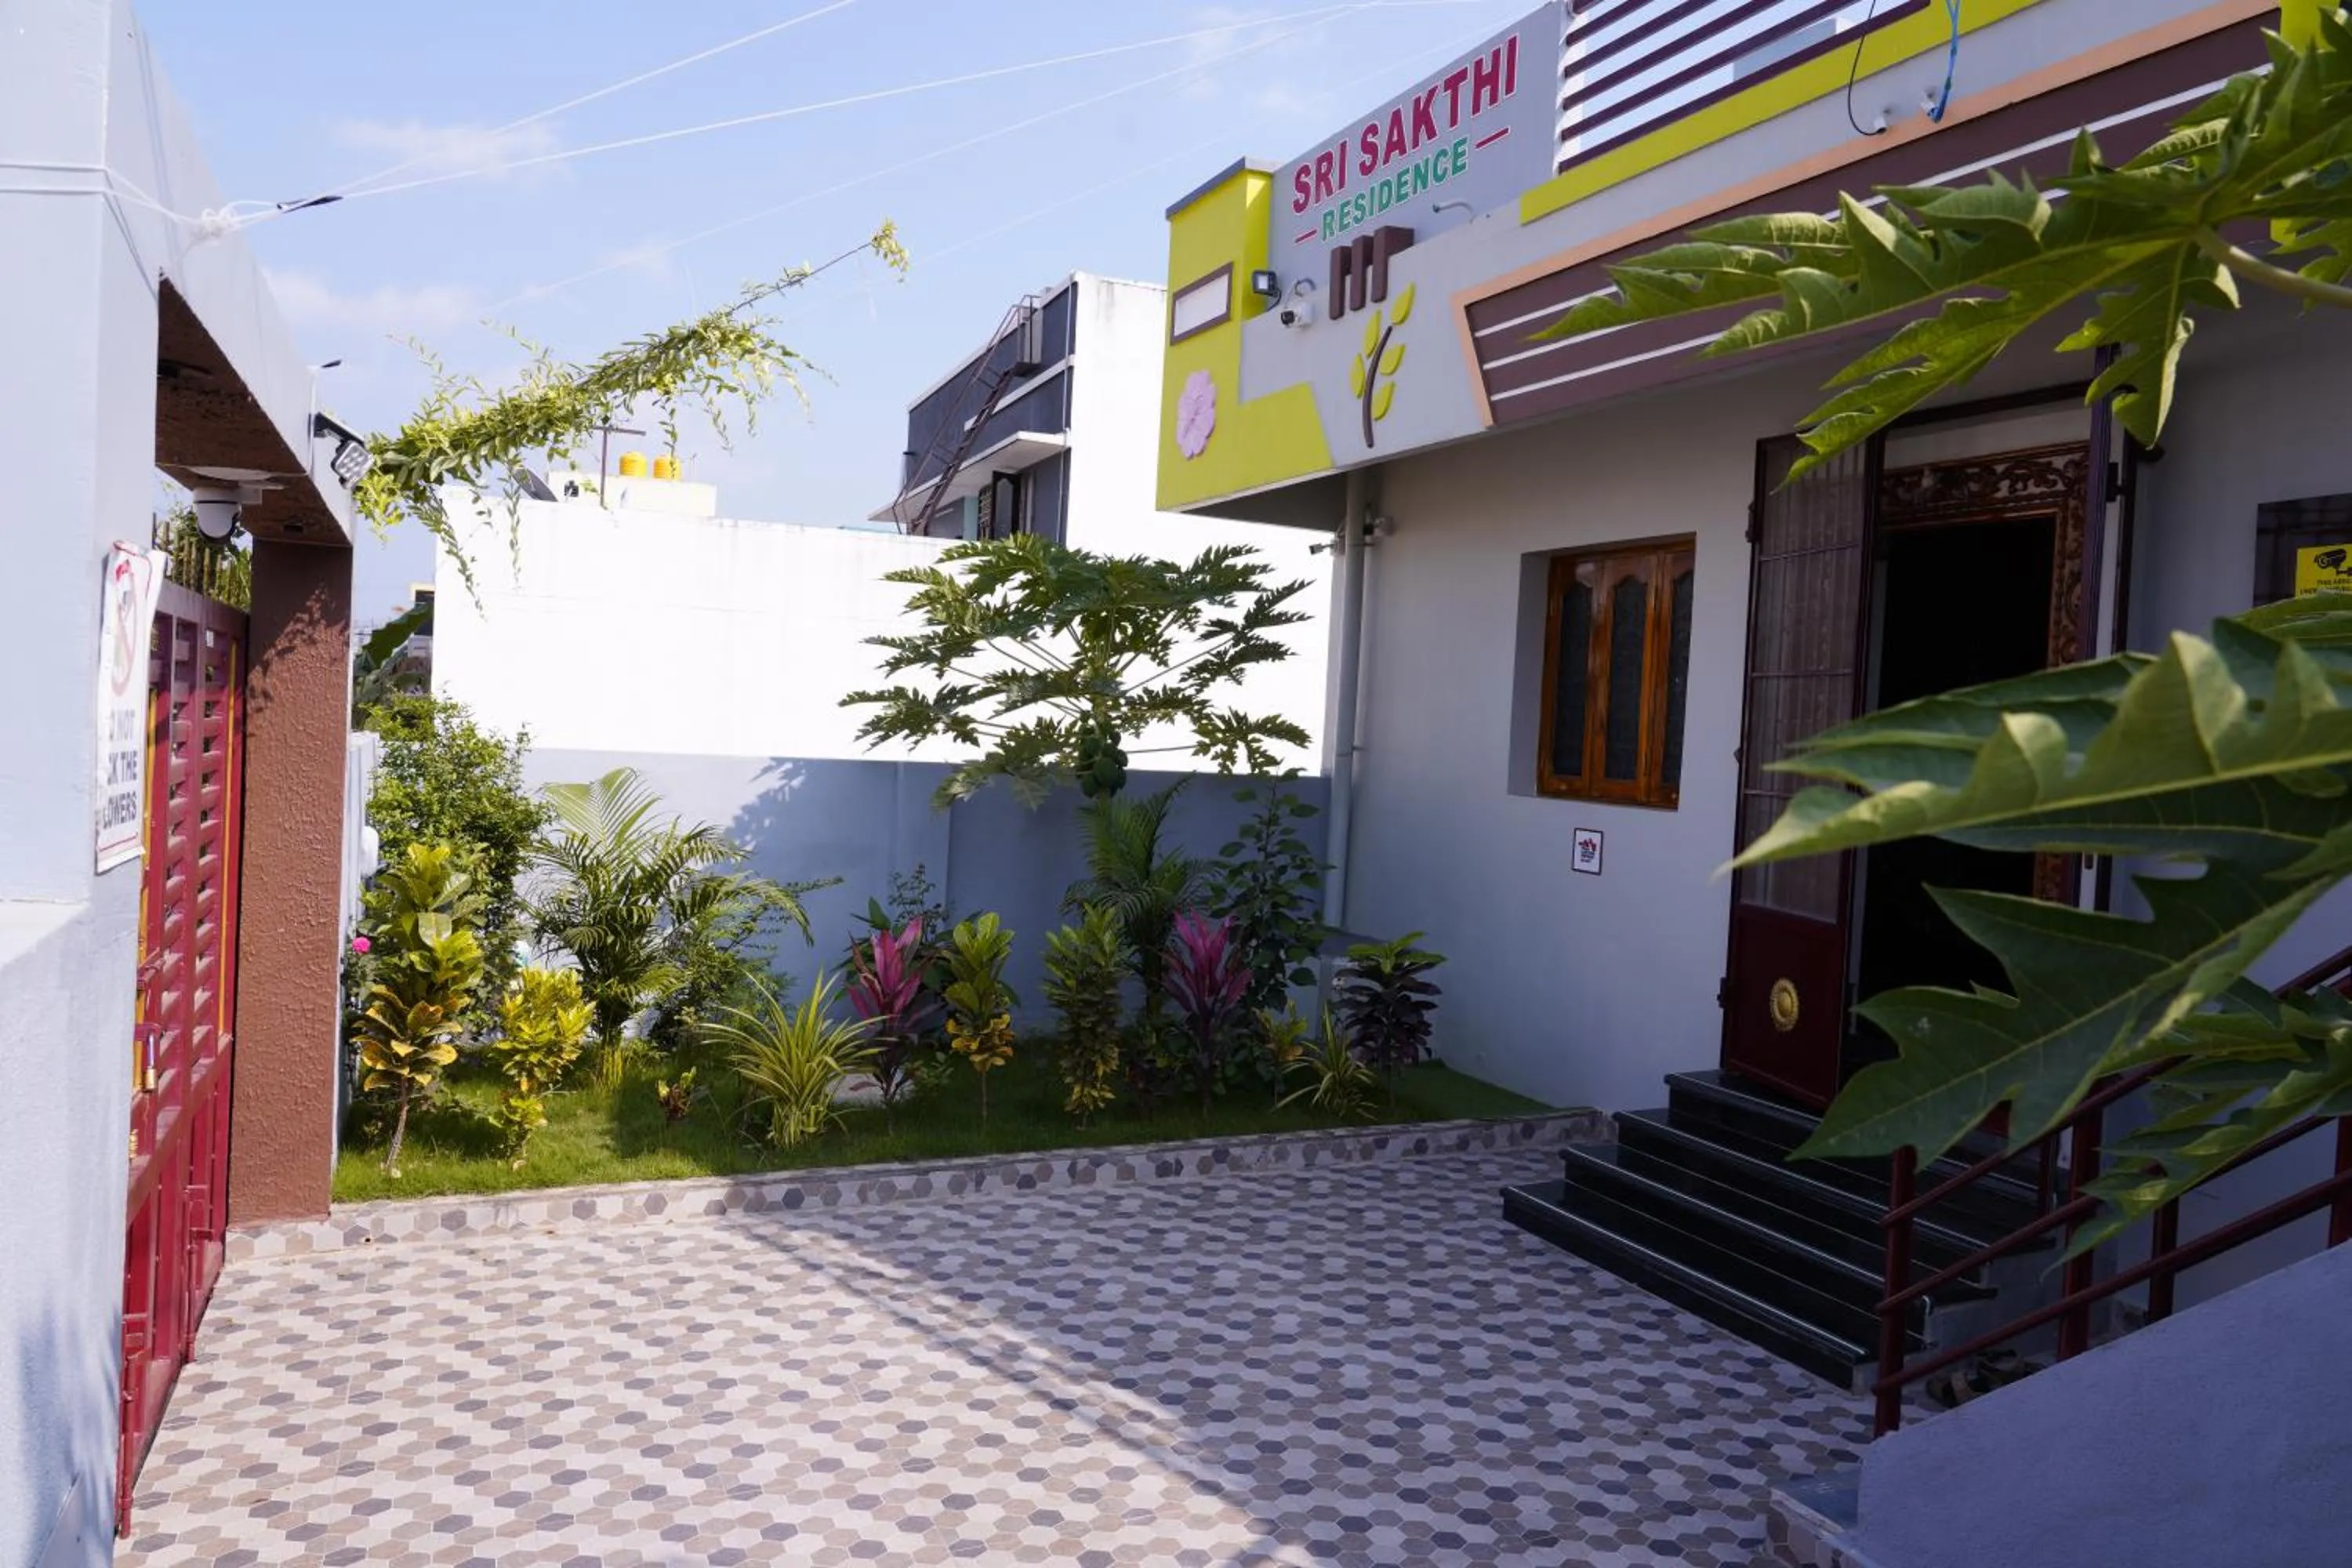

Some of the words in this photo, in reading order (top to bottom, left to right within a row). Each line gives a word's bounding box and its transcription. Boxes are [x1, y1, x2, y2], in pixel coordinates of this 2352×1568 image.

[1293, 140, 1348, 215] SRI
[1358, 34, 1519, 176] SAKTHI
[1321, 136, 1468, 241] RESIDENCE
[120, 750, 137, 782] THE
